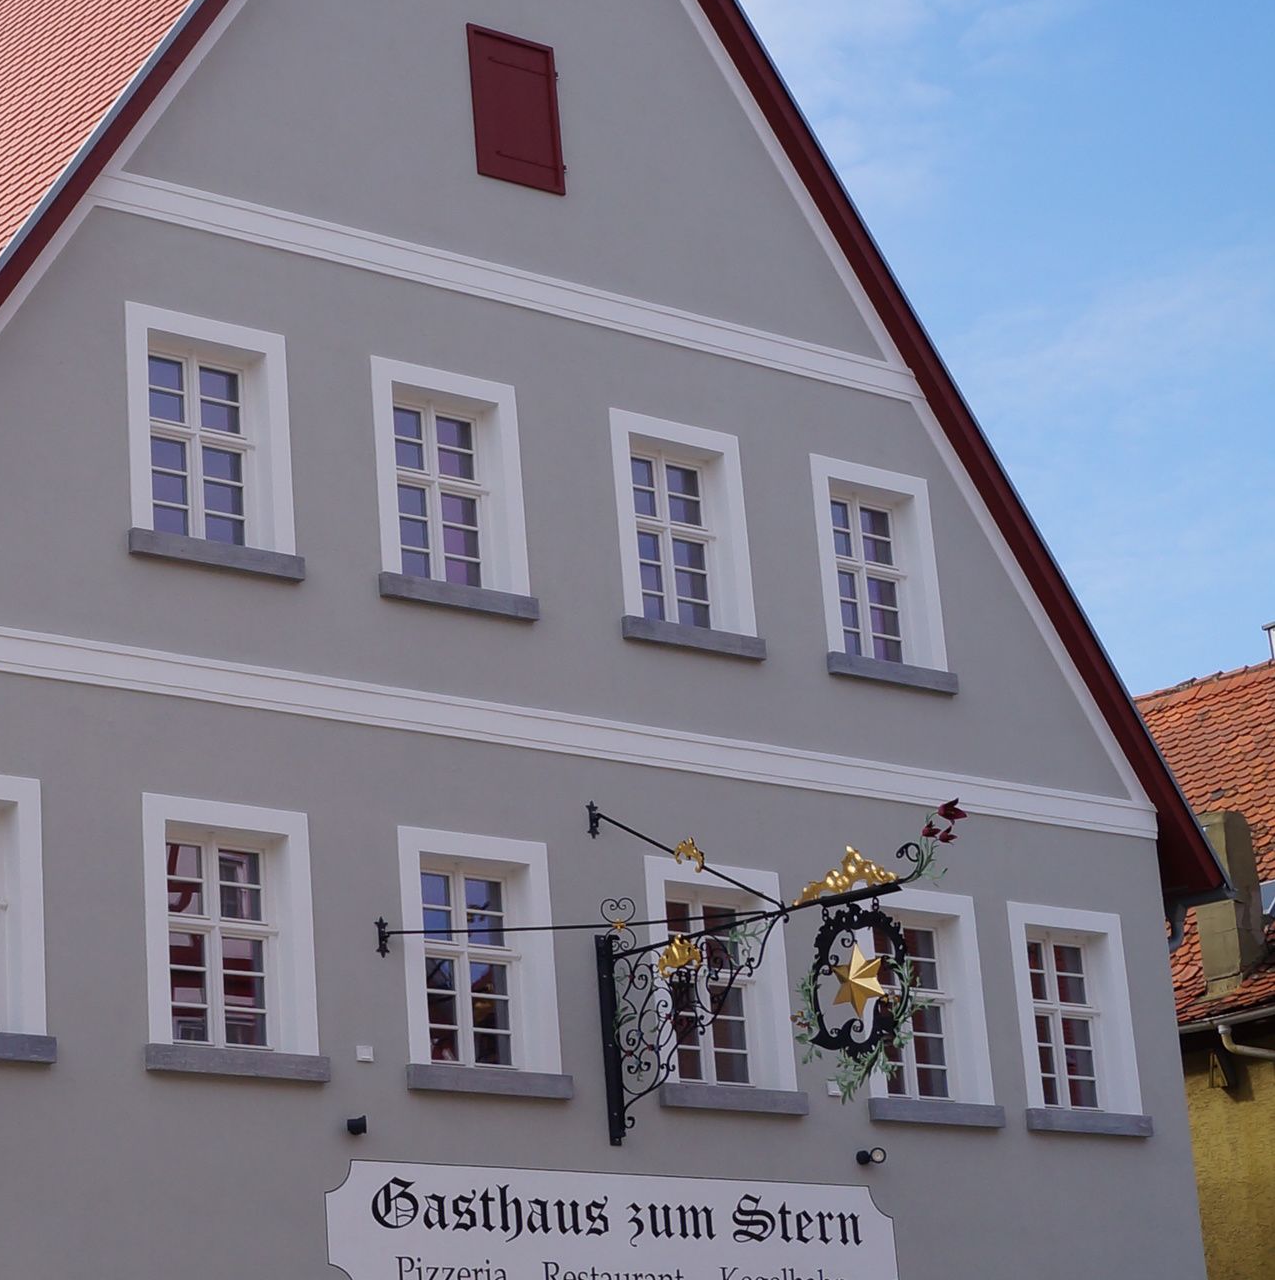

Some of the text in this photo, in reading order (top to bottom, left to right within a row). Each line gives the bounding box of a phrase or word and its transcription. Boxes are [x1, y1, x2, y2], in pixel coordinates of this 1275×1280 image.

[371, 1177, 864, 1247] Gasthaus zum Stern
